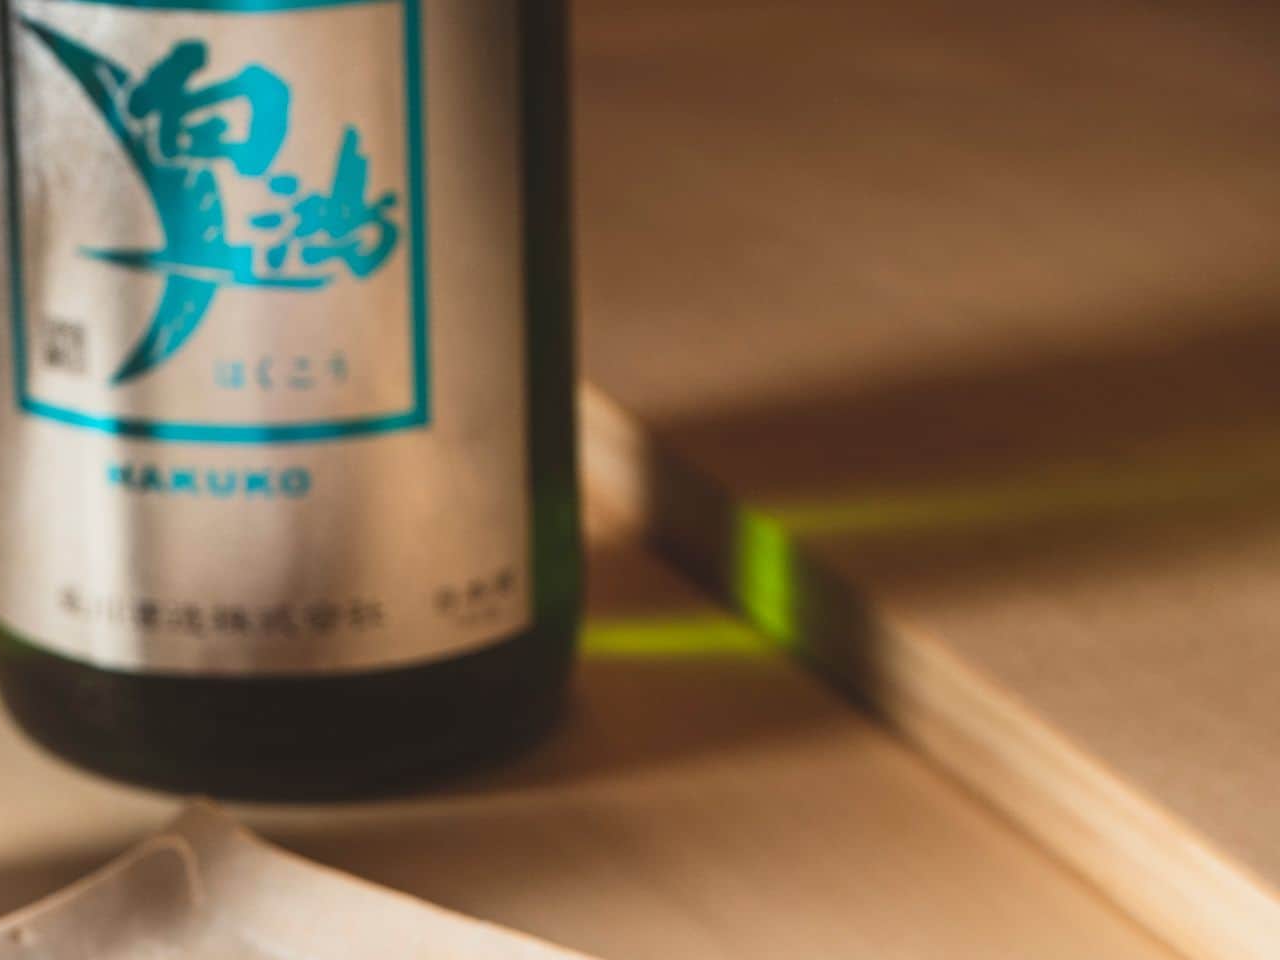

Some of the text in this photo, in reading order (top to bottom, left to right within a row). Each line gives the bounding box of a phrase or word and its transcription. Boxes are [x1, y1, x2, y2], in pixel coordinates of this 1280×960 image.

[214, 349, 350, 391] はくこう
[107, 460, 312, 499] HAKUKO
